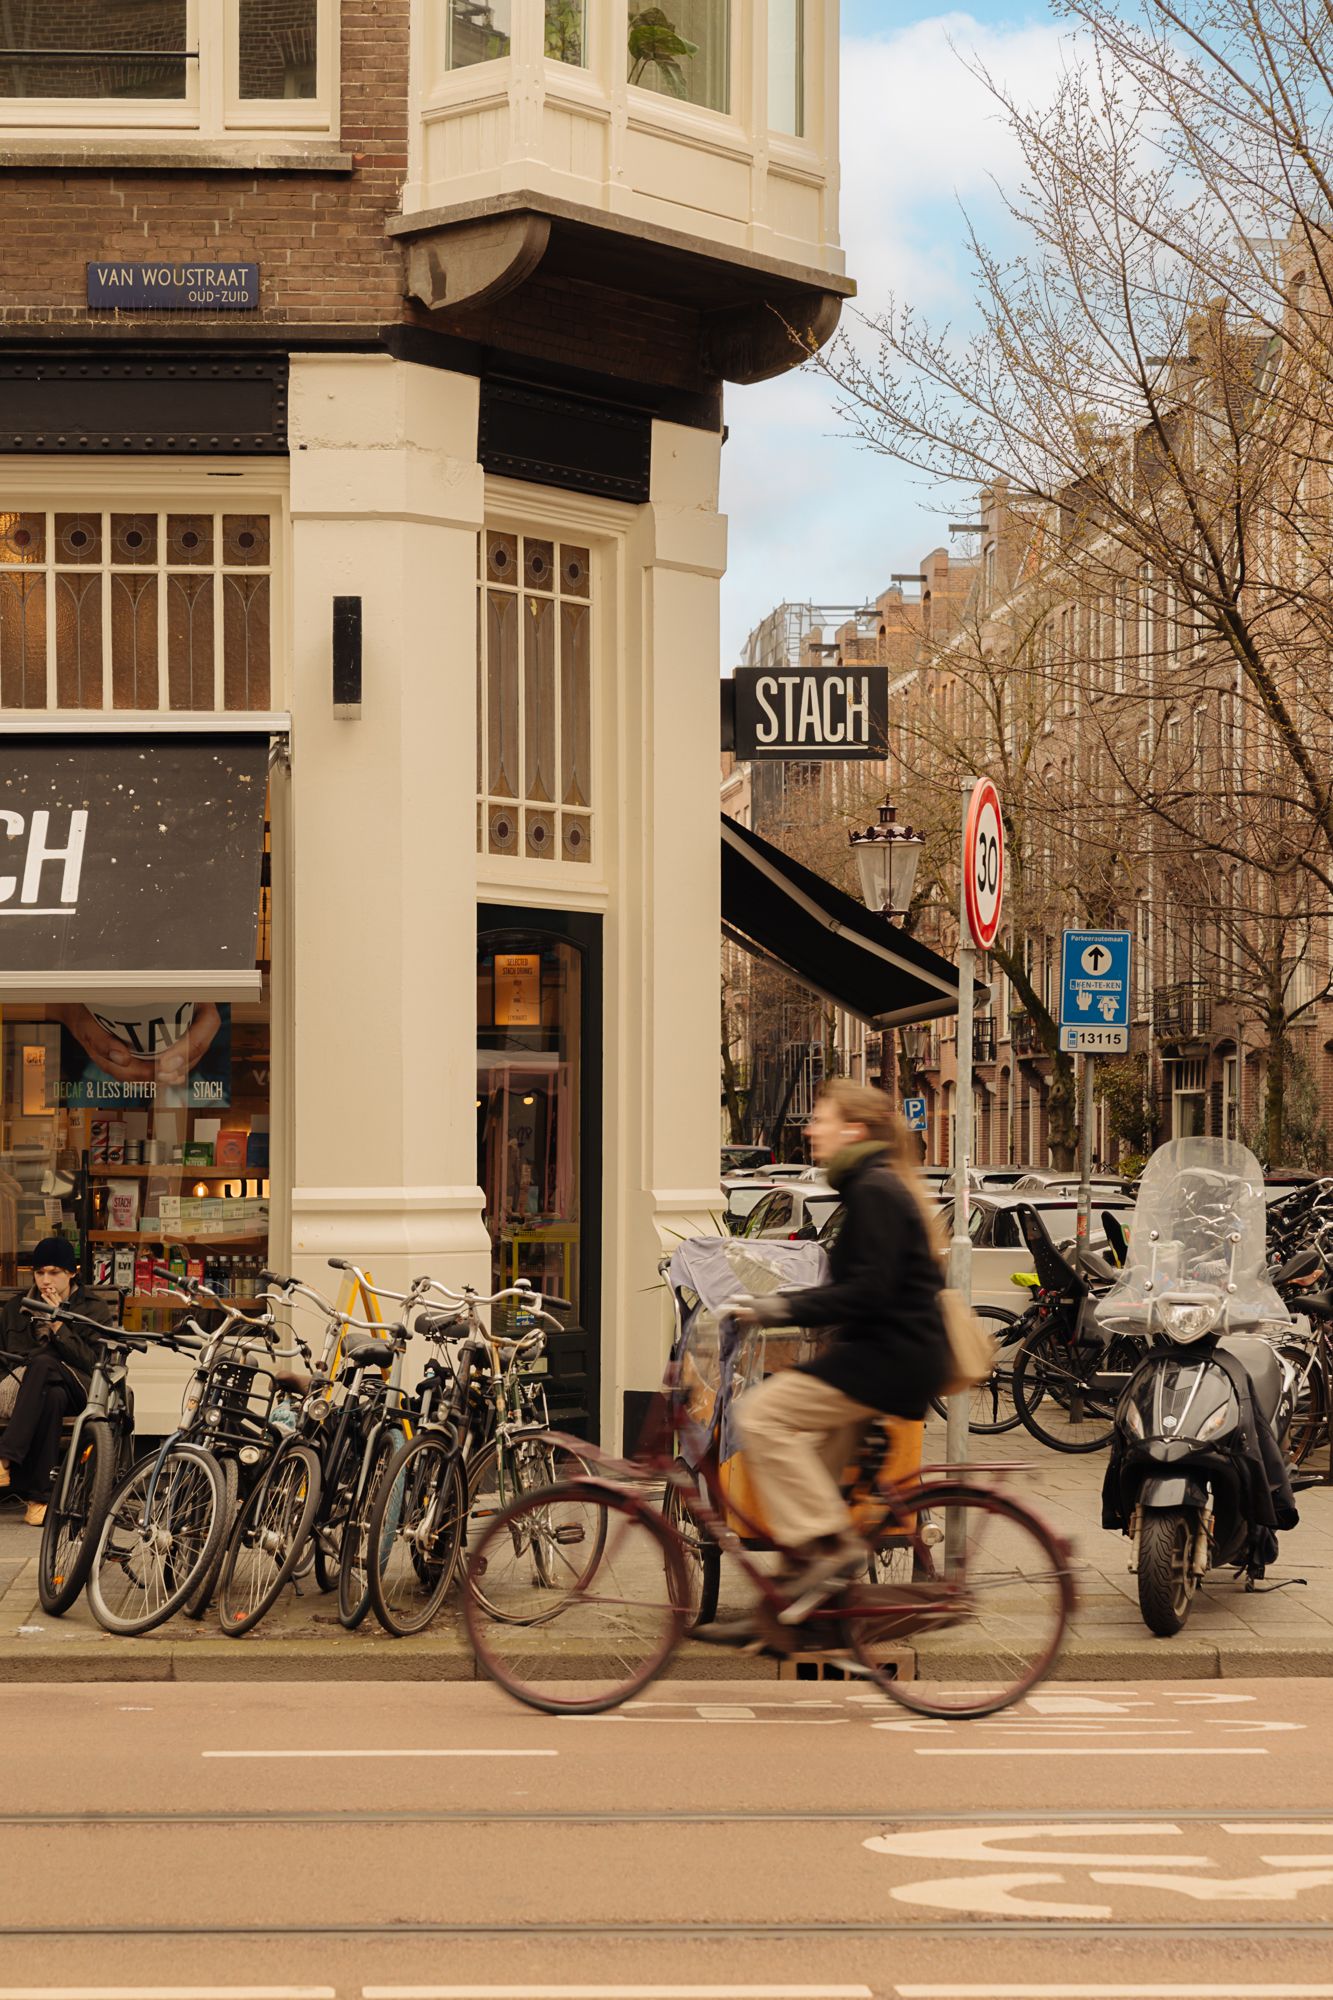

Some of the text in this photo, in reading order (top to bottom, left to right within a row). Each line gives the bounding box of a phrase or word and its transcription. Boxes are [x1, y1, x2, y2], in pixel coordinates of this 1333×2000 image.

[97, 268, 249, 286] VAN WOUSTRAAT
[188, 290, 249, 303] OUD-ZUID
[755, 676, 869, 743] STACH
[977, 831, 998, 896] 30
[1070, 934, 1124, 943] Parkeerautomaat
[1079, 1032, 1122, 1045] 13115
[53, 1081, 157, 1099] DECAF & LESS BITTER
[193, 1081, 223, 1099] STACH
[909, 1100, 922, 1118] P
